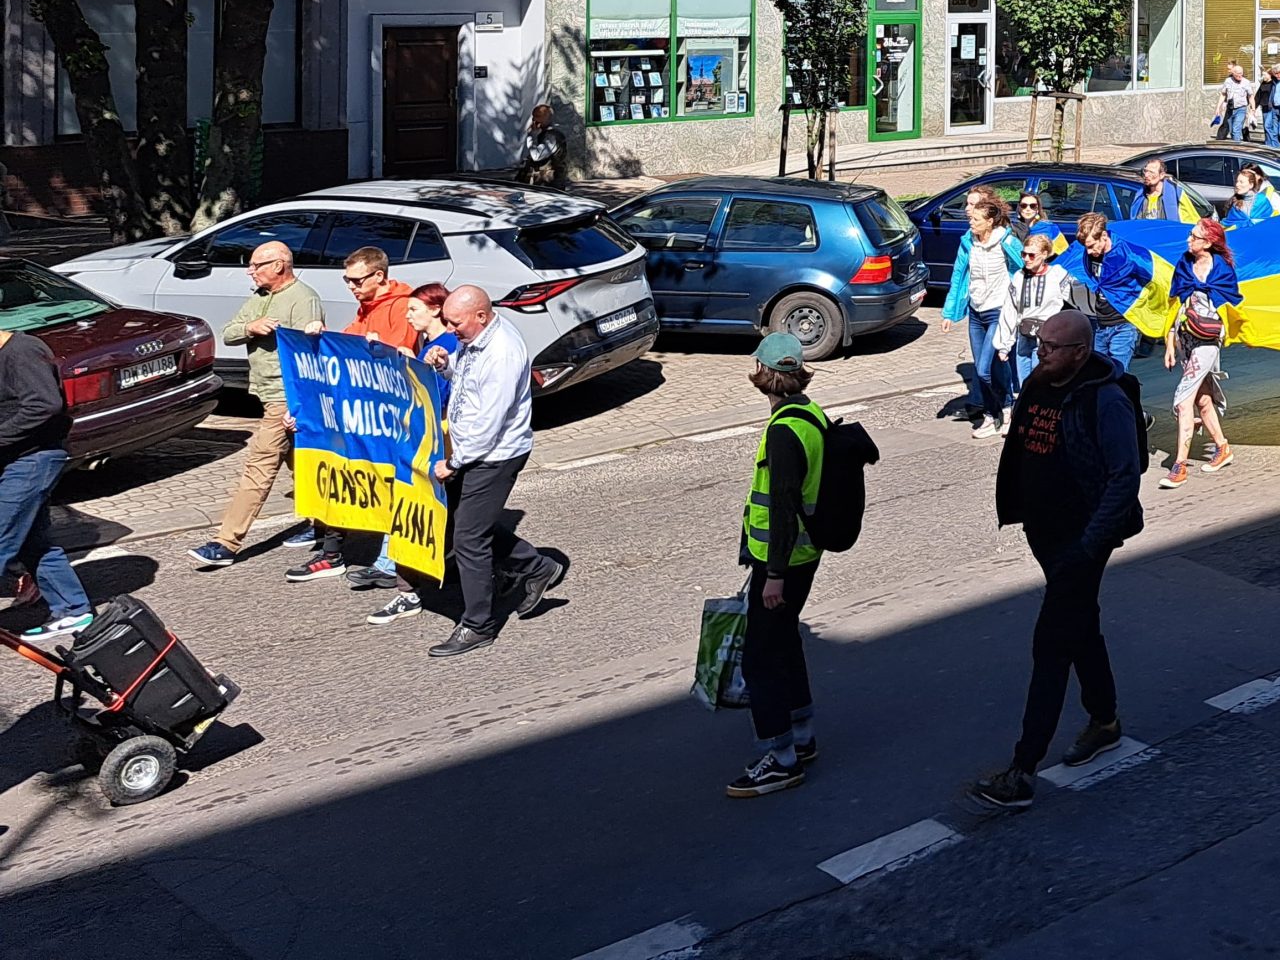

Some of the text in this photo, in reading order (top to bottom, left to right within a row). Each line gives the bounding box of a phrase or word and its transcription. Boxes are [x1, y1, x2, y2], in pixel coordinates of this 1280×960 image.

[486, 13, 493, 25] 5
[345, 357, 410, 401] WOLNOŚCI
[319, 393, 403, 444] NIE MILCZY
[1039, 407, 1062, 420] WILL
[1032, 416, 1056, 431] RAVE
